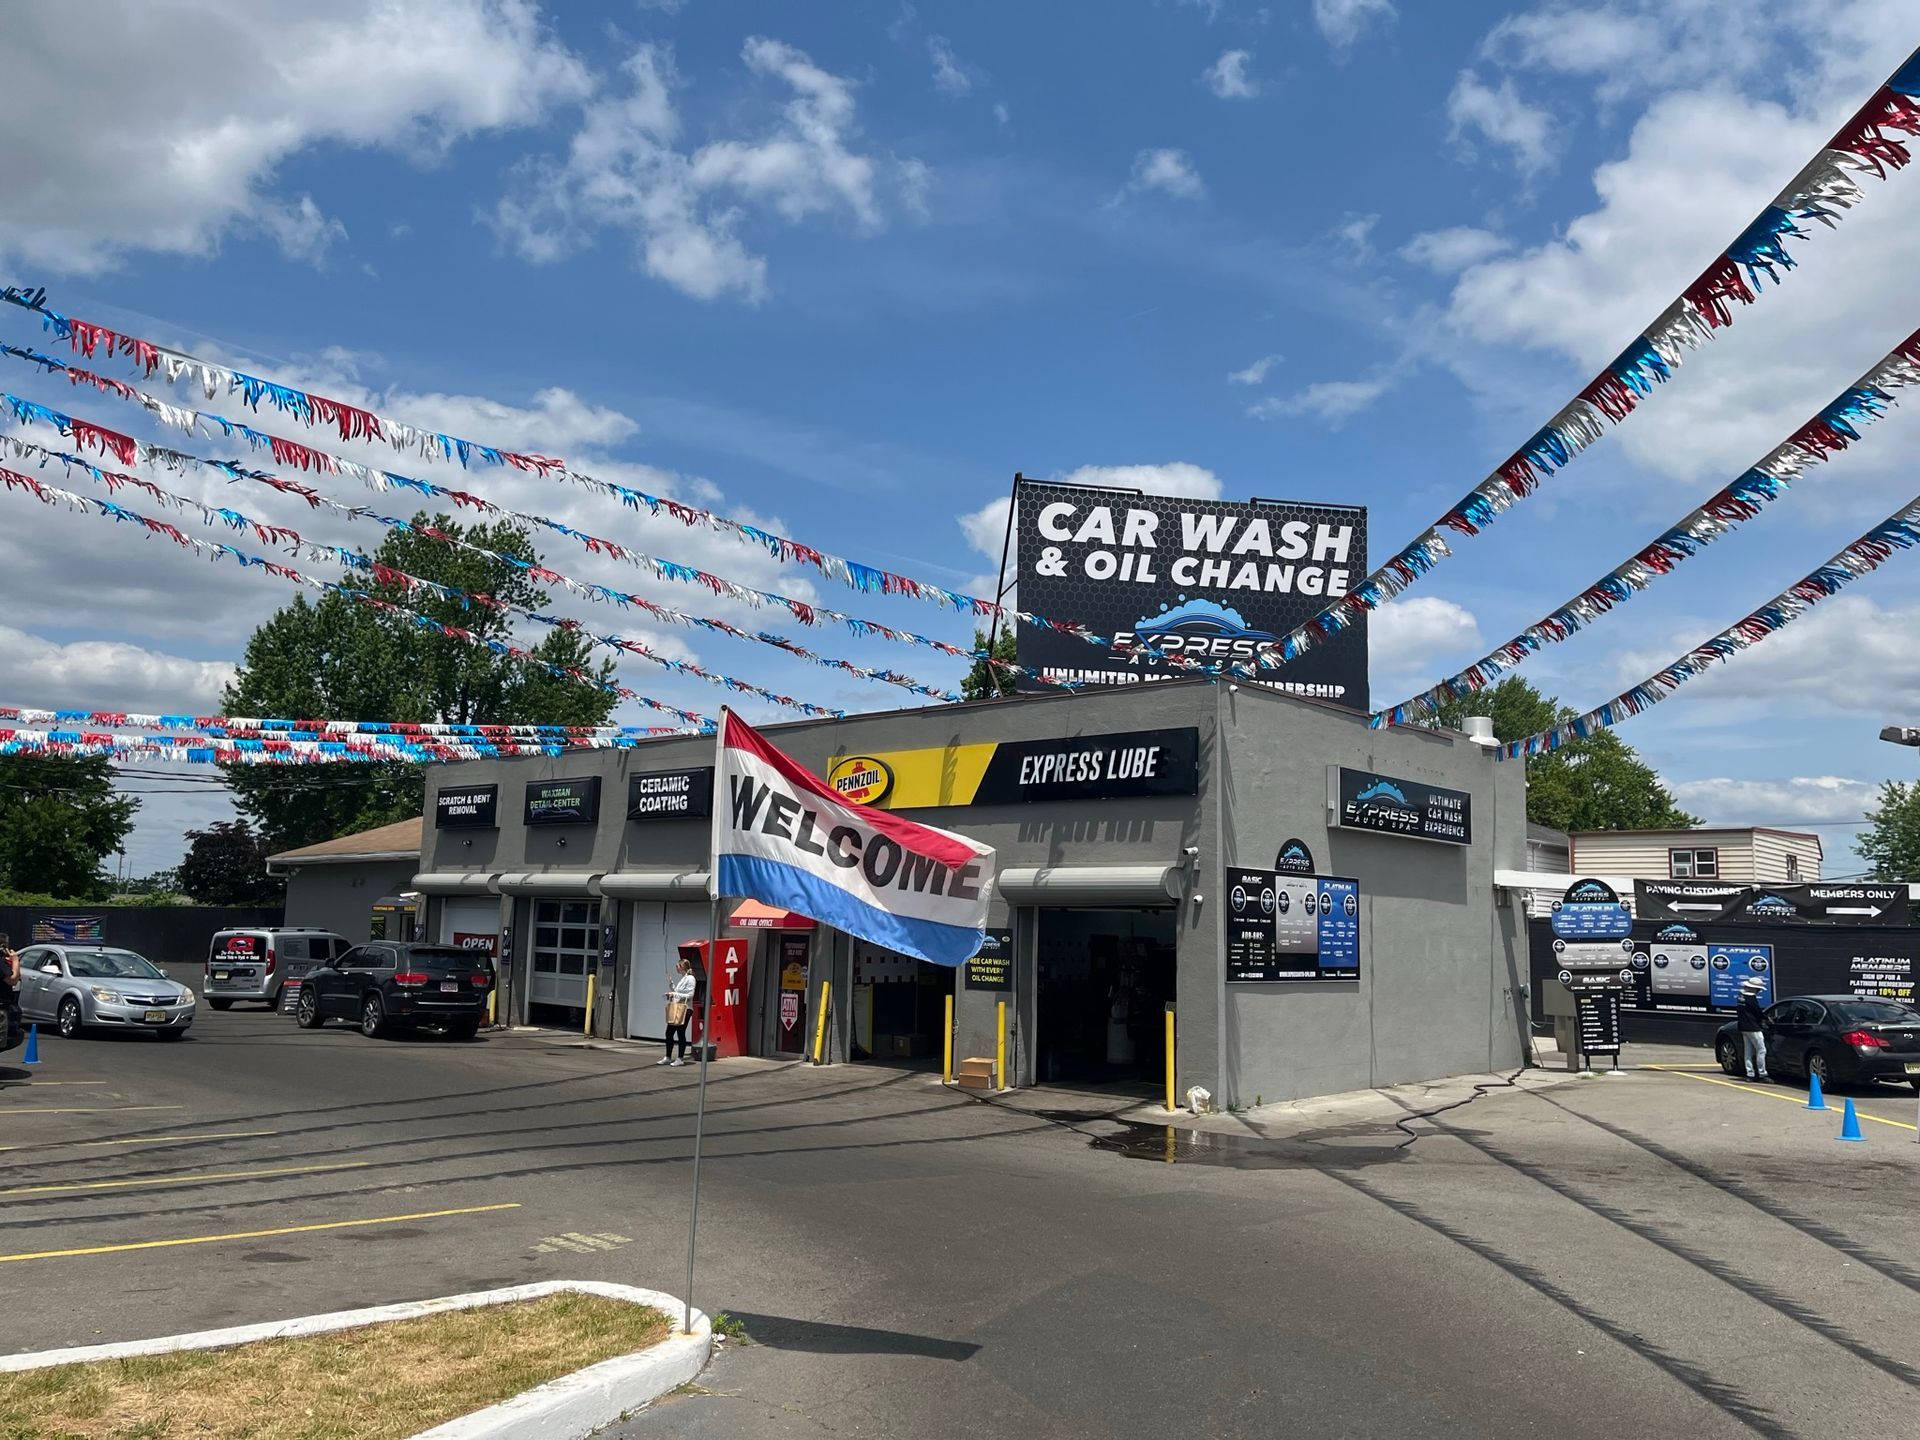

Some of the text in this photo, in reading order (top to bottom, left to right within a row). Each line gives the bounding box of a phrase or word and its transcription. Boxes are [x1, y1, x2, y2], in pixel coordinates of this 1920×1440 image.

[1037, 502, 1353, 563] CAR WASH
[1035, 546, 1350, 597] & OIL CHANGE
[1043, 667, 1139, 684] UNLIMITED
[1020, 747, 1160, 785] EXPRESS LUBE
[640, 775, 690, 793] CERAMIC
[836, 769, 880, 792] PENNZOIL
[439, 794, 491, 806] SCRATCH & DENT
[541, 788, 571, 798] WAXMAN
[448, 805, 477, 815] REMOVAL
[553, 798, 581, 807] CENTER
[639, 794, 688, 812] COATING
[1429, 794, 1462, 810] ULTIMATE
[1346, 800, 1420, 824] EXPRESS
[1427, 808, 1463, 824] CAR WASH
[1354, 815, 1412, 831] AUTO SPA
[1424, 821, 1465, 837] EXPERIENCE
[730, 775, 988, 900] WELCOME
[1646, 886, 1742, 895] PAYING CUSTOMERS
[1810, 889, 1896, 899] MEMBERS ONLY
[462, 938, 494, 950] OPEN
[1850, 963, 1911, 971] MEMBERS
[1852, 957, 1911, 965] PLATINUM
[725, 946, 740, 1006] ATM
[981, 975, 1004, 983] CHANGE
[1878, 980, 1915, 988] MEMBERSHIP
[1878, 988, 1896, 996] 10%
[1897, 988, 1911, 996] OFF
[782, 998, 796, 1011] ATM
